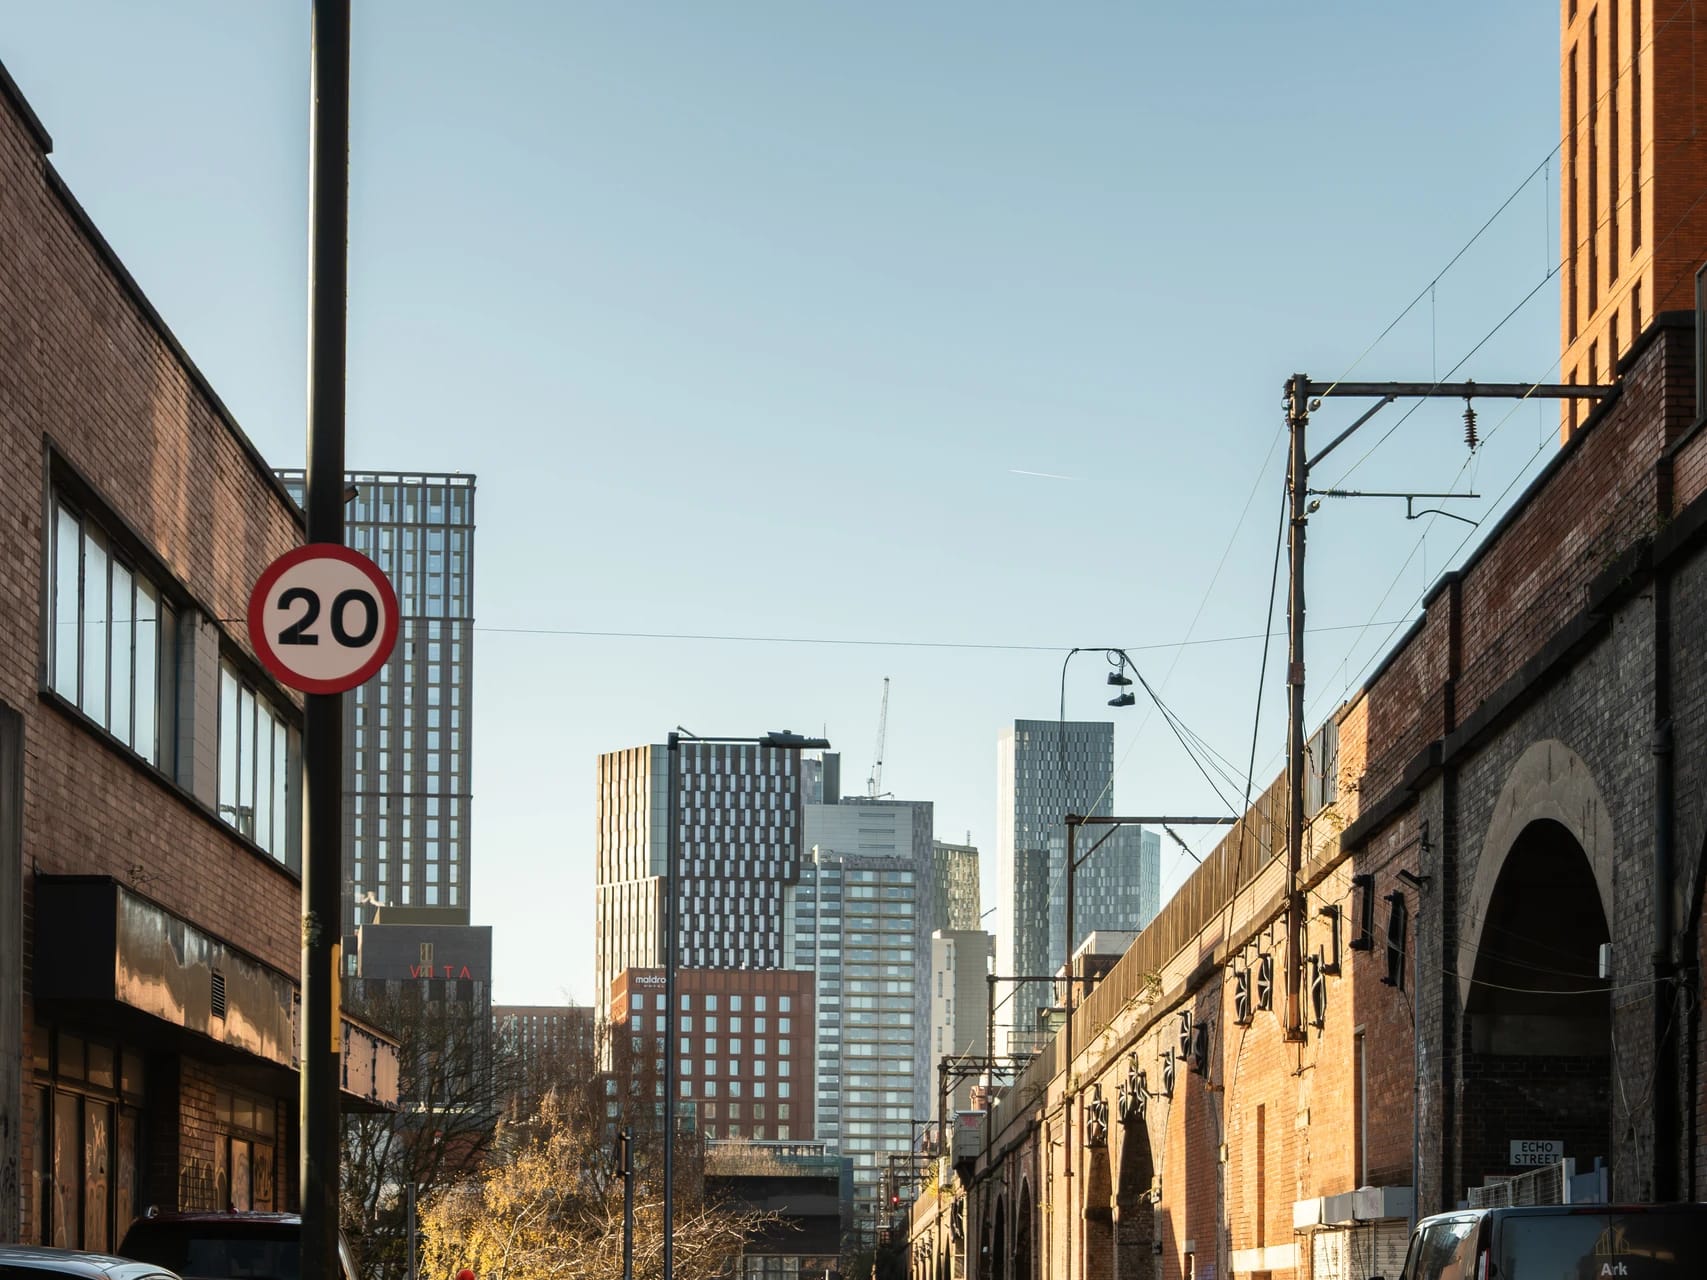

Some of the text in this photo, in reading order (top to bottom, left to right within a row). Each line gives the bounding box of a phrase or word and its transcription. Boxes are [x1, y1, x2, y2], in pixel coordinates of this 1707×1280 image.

[277, 587, 379, 648] 20
[409, 964, 473, 980] VITA
[635, 975, 667, 984] maldro
[1521, 1142, 1553, 1153] ECHO
[1514, 1153, 1559, 1165] STREET
[1600, 1261, 1628, 1276] Ark
